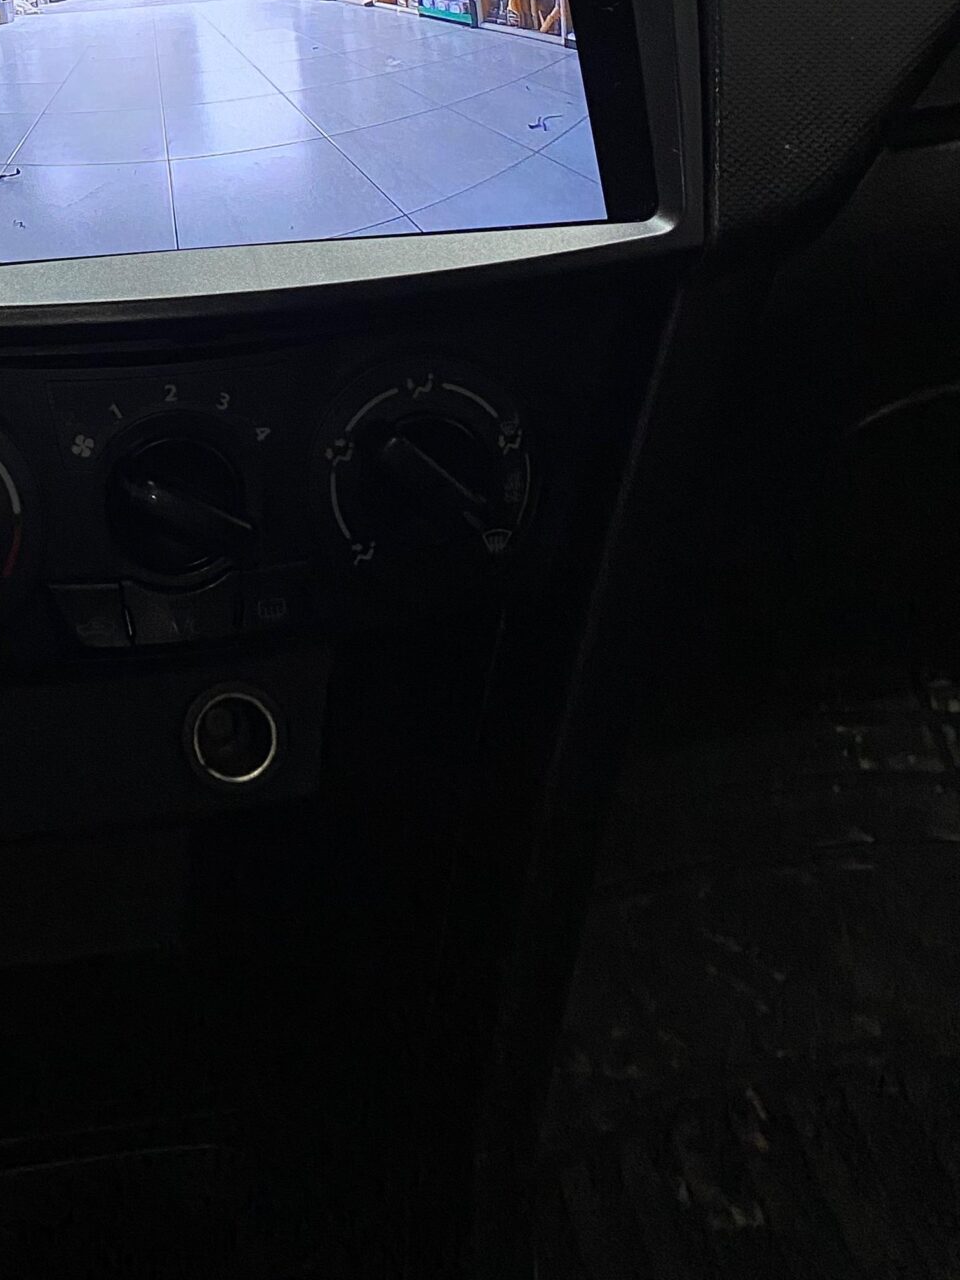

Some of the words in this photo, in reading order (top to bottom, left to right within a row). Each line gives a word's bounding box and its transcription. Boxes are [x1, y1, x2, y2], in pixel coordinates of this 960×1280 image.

[108, 402, 123, 419] 1
[163, 384, 178, 401] 2
[215, 392, 230, 410] 3
[255, 426, 271, 441] 4
